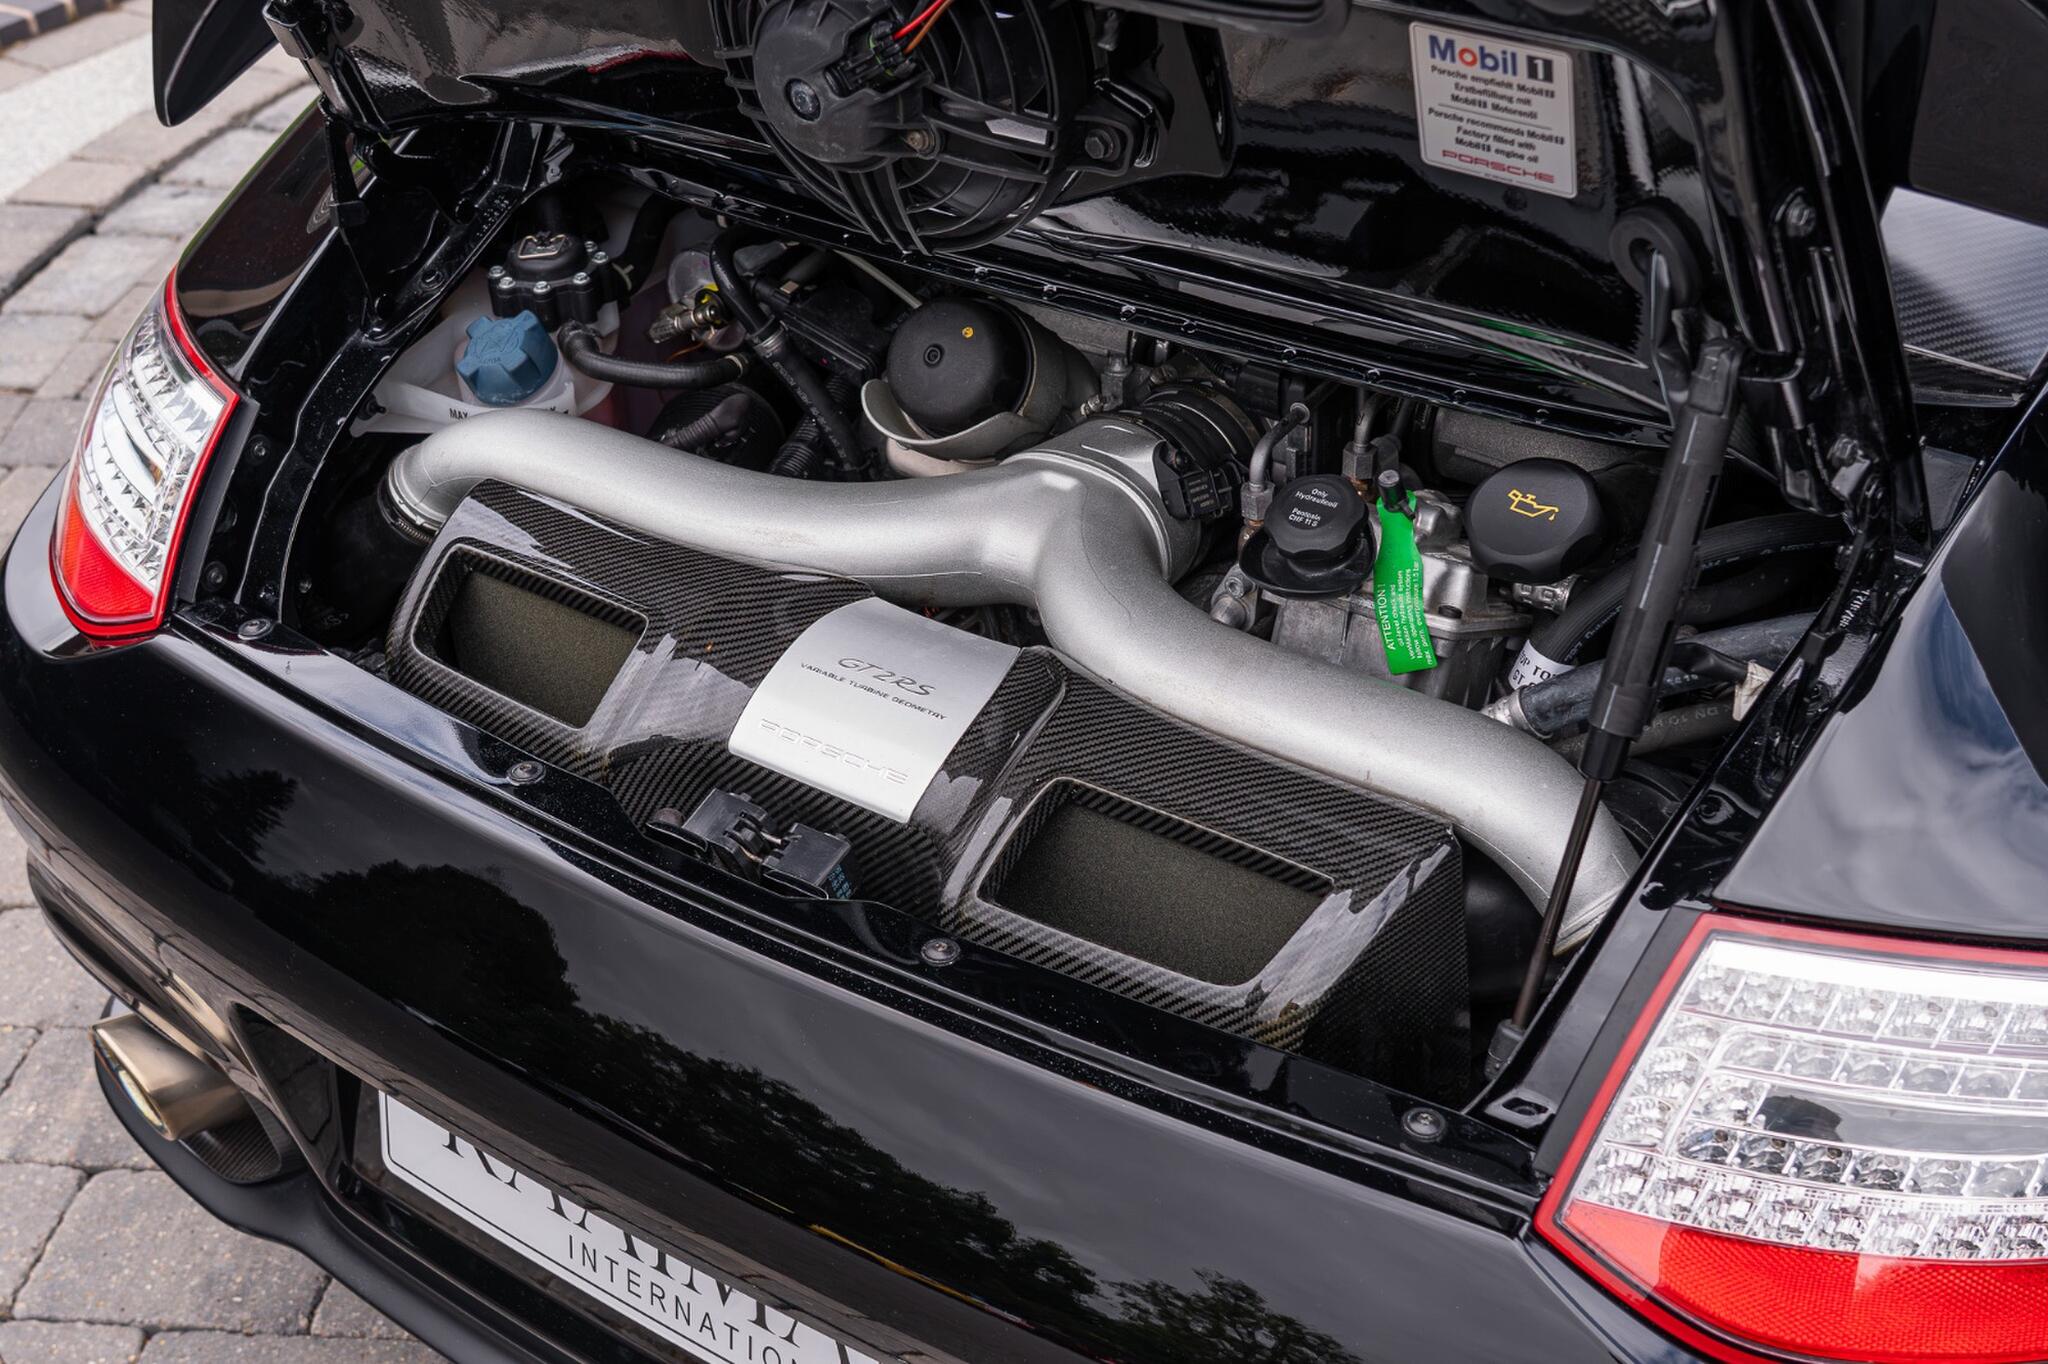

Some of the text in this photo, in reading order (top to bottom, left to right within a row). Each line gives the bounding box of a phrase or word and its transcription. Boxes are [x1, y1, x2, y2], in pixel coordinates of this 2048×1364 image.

[1428, 35, 1518, 77] Mobil
[1431, 65, 1468, 79] Porsche
[1470, 75, 1514, 91] empfiehlt
[1454, 82, 1532, 107] Erstbefüllung mit
[1428, 107, 1463, 122] Porsche
[1466, 118, 1525, 137] recommends
[1490, 103, 1538, 120] Motorenöl
[1456, 126, 1536, 151] Factory filled with
[1441, 150, 1555, 184] PORSCHE
[1494, 149, 1525, 160] engine
[1526, 155, 1539, 163] oil
[1311, 488, 1328, 499] Only
[1289, 513, 1304, 523] CHF
[1292, 507, 1321, 521] Pentosin
[1413, 584, 1423, 626] overpressure
[1377, 589, 1396, 650] ATTENTION
[1393, 620, 1402, 637] level
[1406, 604, 1417, 638] operating
[800, 662, 948, 720] VARIABLE TURBINE GEOMETRY
[759, 718, 909, 785] PORSCHE
[568, 1234, 798, 1364] INTERNATIO
